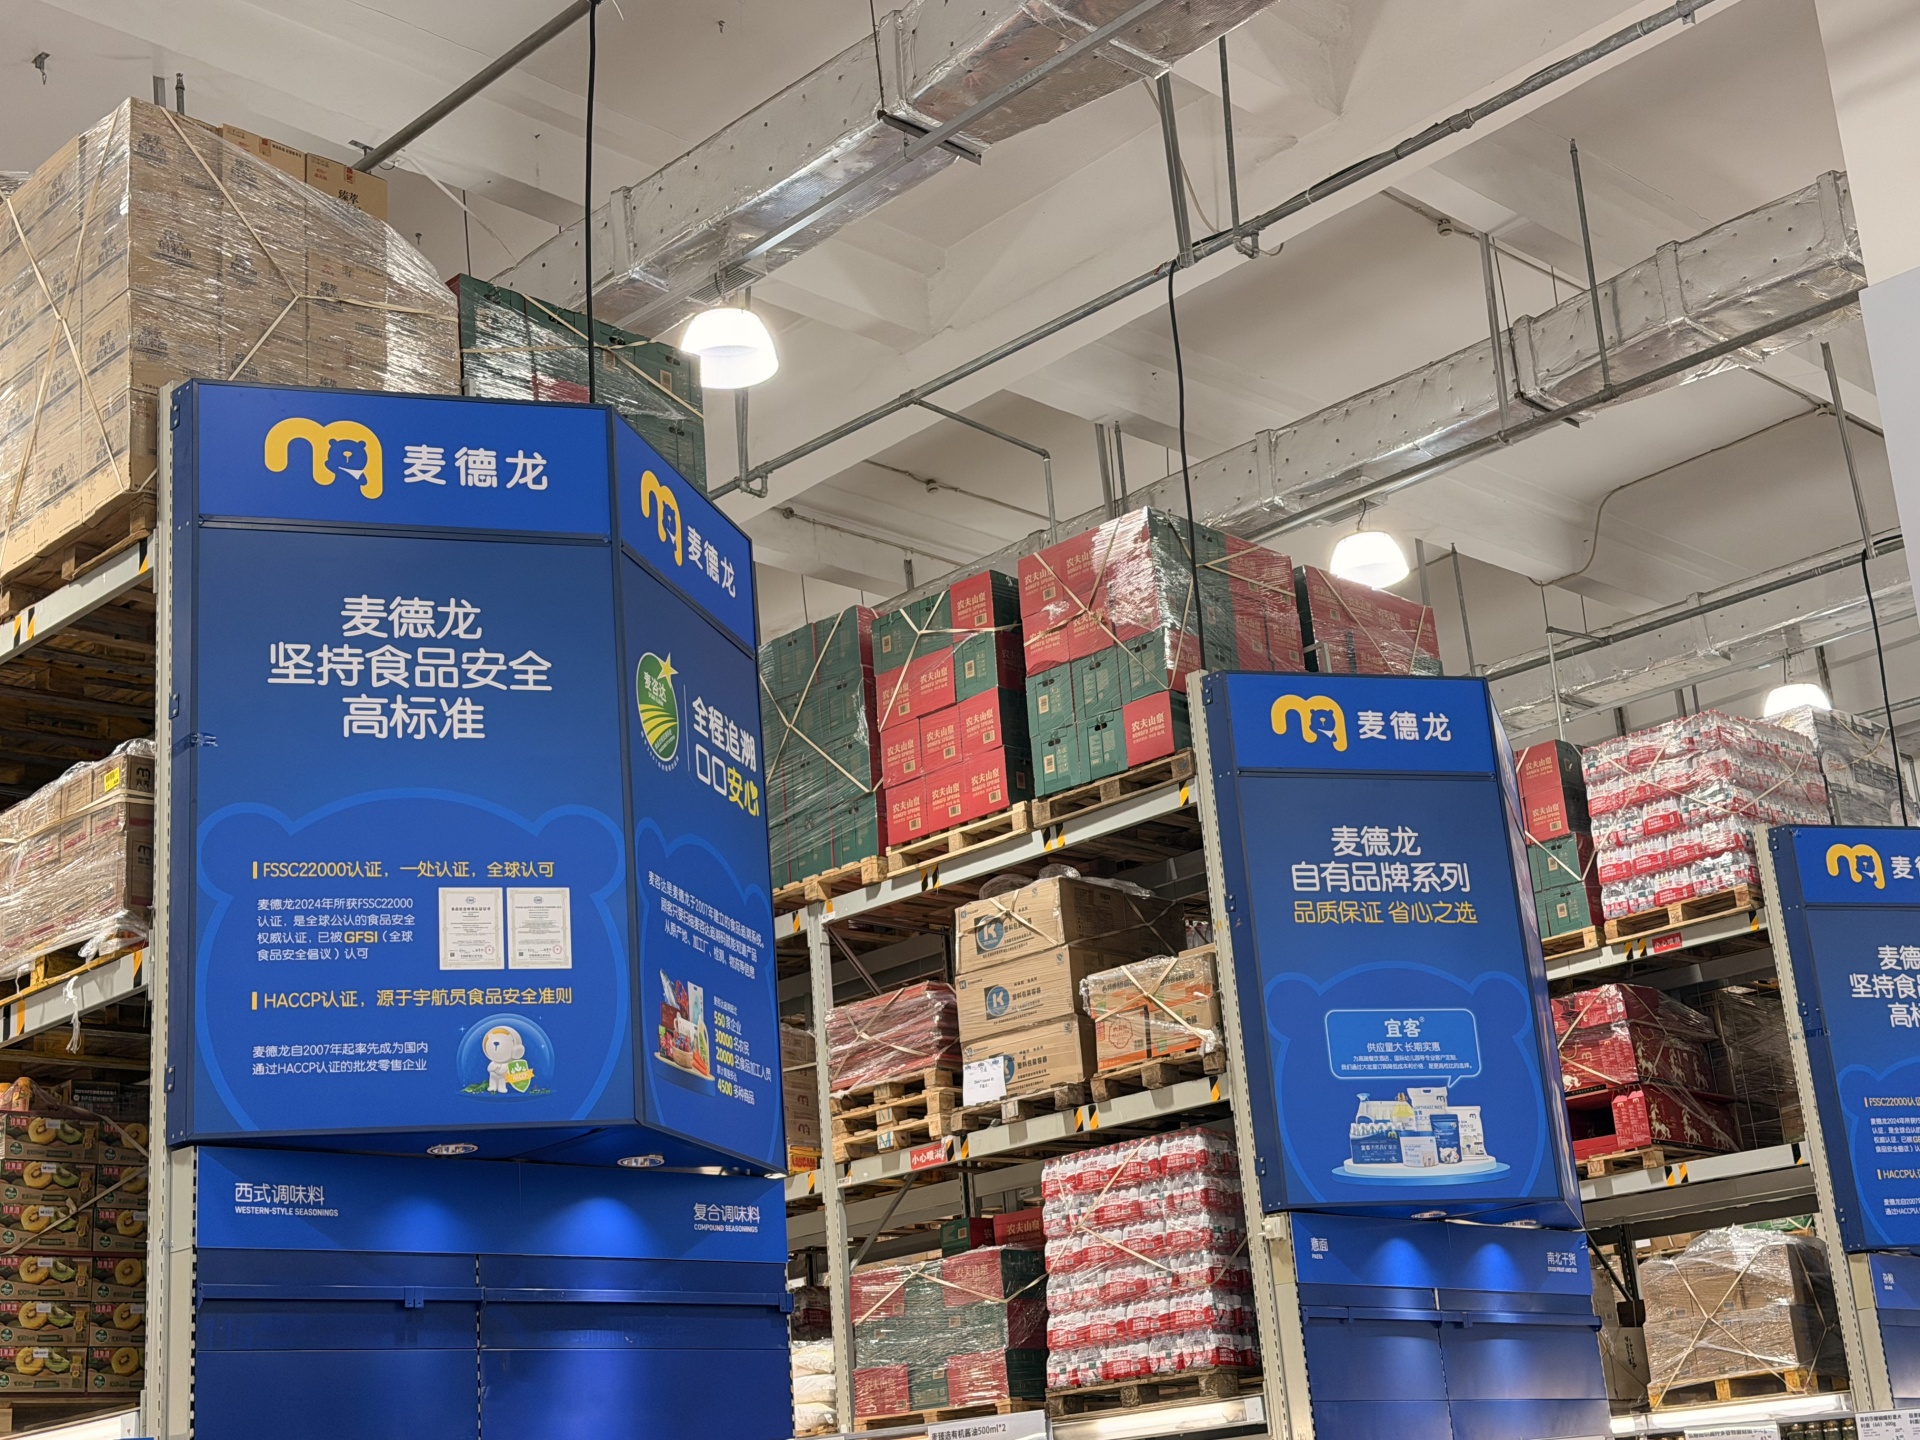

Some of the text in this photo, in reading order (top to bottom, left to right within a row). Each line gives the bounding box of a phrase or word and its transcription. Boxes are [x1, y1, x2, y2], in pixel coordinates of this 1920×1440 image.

[403, 444, 548, 490] 麦德龙
[687, 525, 736, 598] 麦德龙
[340, 594, 482, 639] 麦德龙
[267, 641, 553, 691] 坚持食品安全
[341, 693, 486, 739] 高标准
[1132, 712, 1164, 731] 农夫山泉
[1357, 710, 1452, 742] 麦德龙
[971, 768, 1000, 786] 农夫山泉
[932, 782, 960, 800] 农夫山泉
[1330, 825, 1421, 857] 麦德龙
[263, 860, 555, 879] FSSC22000认证，一处认证，全球认可
[1291, 861, 1470, 893] 自有品牌系列
[257, 896, 414, 911] 麦德龙2024年所获FSSC22000
[1294, 900, 1478, 924] 品质保证 省心之选
[257, 913, 416, 927] 认证，是全球公认的食品安全
[1849, 973, 1920, 999] 坚持食
[264, 988, 573, 1009] HACCP认证，源于宇航员食品安全准则
[714, 1010, 726, 1028] 550
[252, 1041, 429, 1058] 麦德龙自2007年起率先成为国内
[716, 1046, 734, 1067] 20000
[1367, 1042, 1440, 1052] 供应量大 长期实惠
[252, 1058, 427, 1076] 通过HACCP认证的批发零售企业
[717, 1078, 732, 1096] 4500
[234, 1182, 325, 1206] 西式调味料
[234, 1206, 339, 1218] WESTERN-STYLE SEASONINGS
[693, 1202, 760, 1224] 复合调味料
[694, 1224, 758, 1232] COMPOUND SEASONINGS
[1007, 1222, 1040, 1235] 农夫山泉
[1310, 1237, 1328, 1252] 意面
[1546, 1251, 1577, 1266] 南北干货
